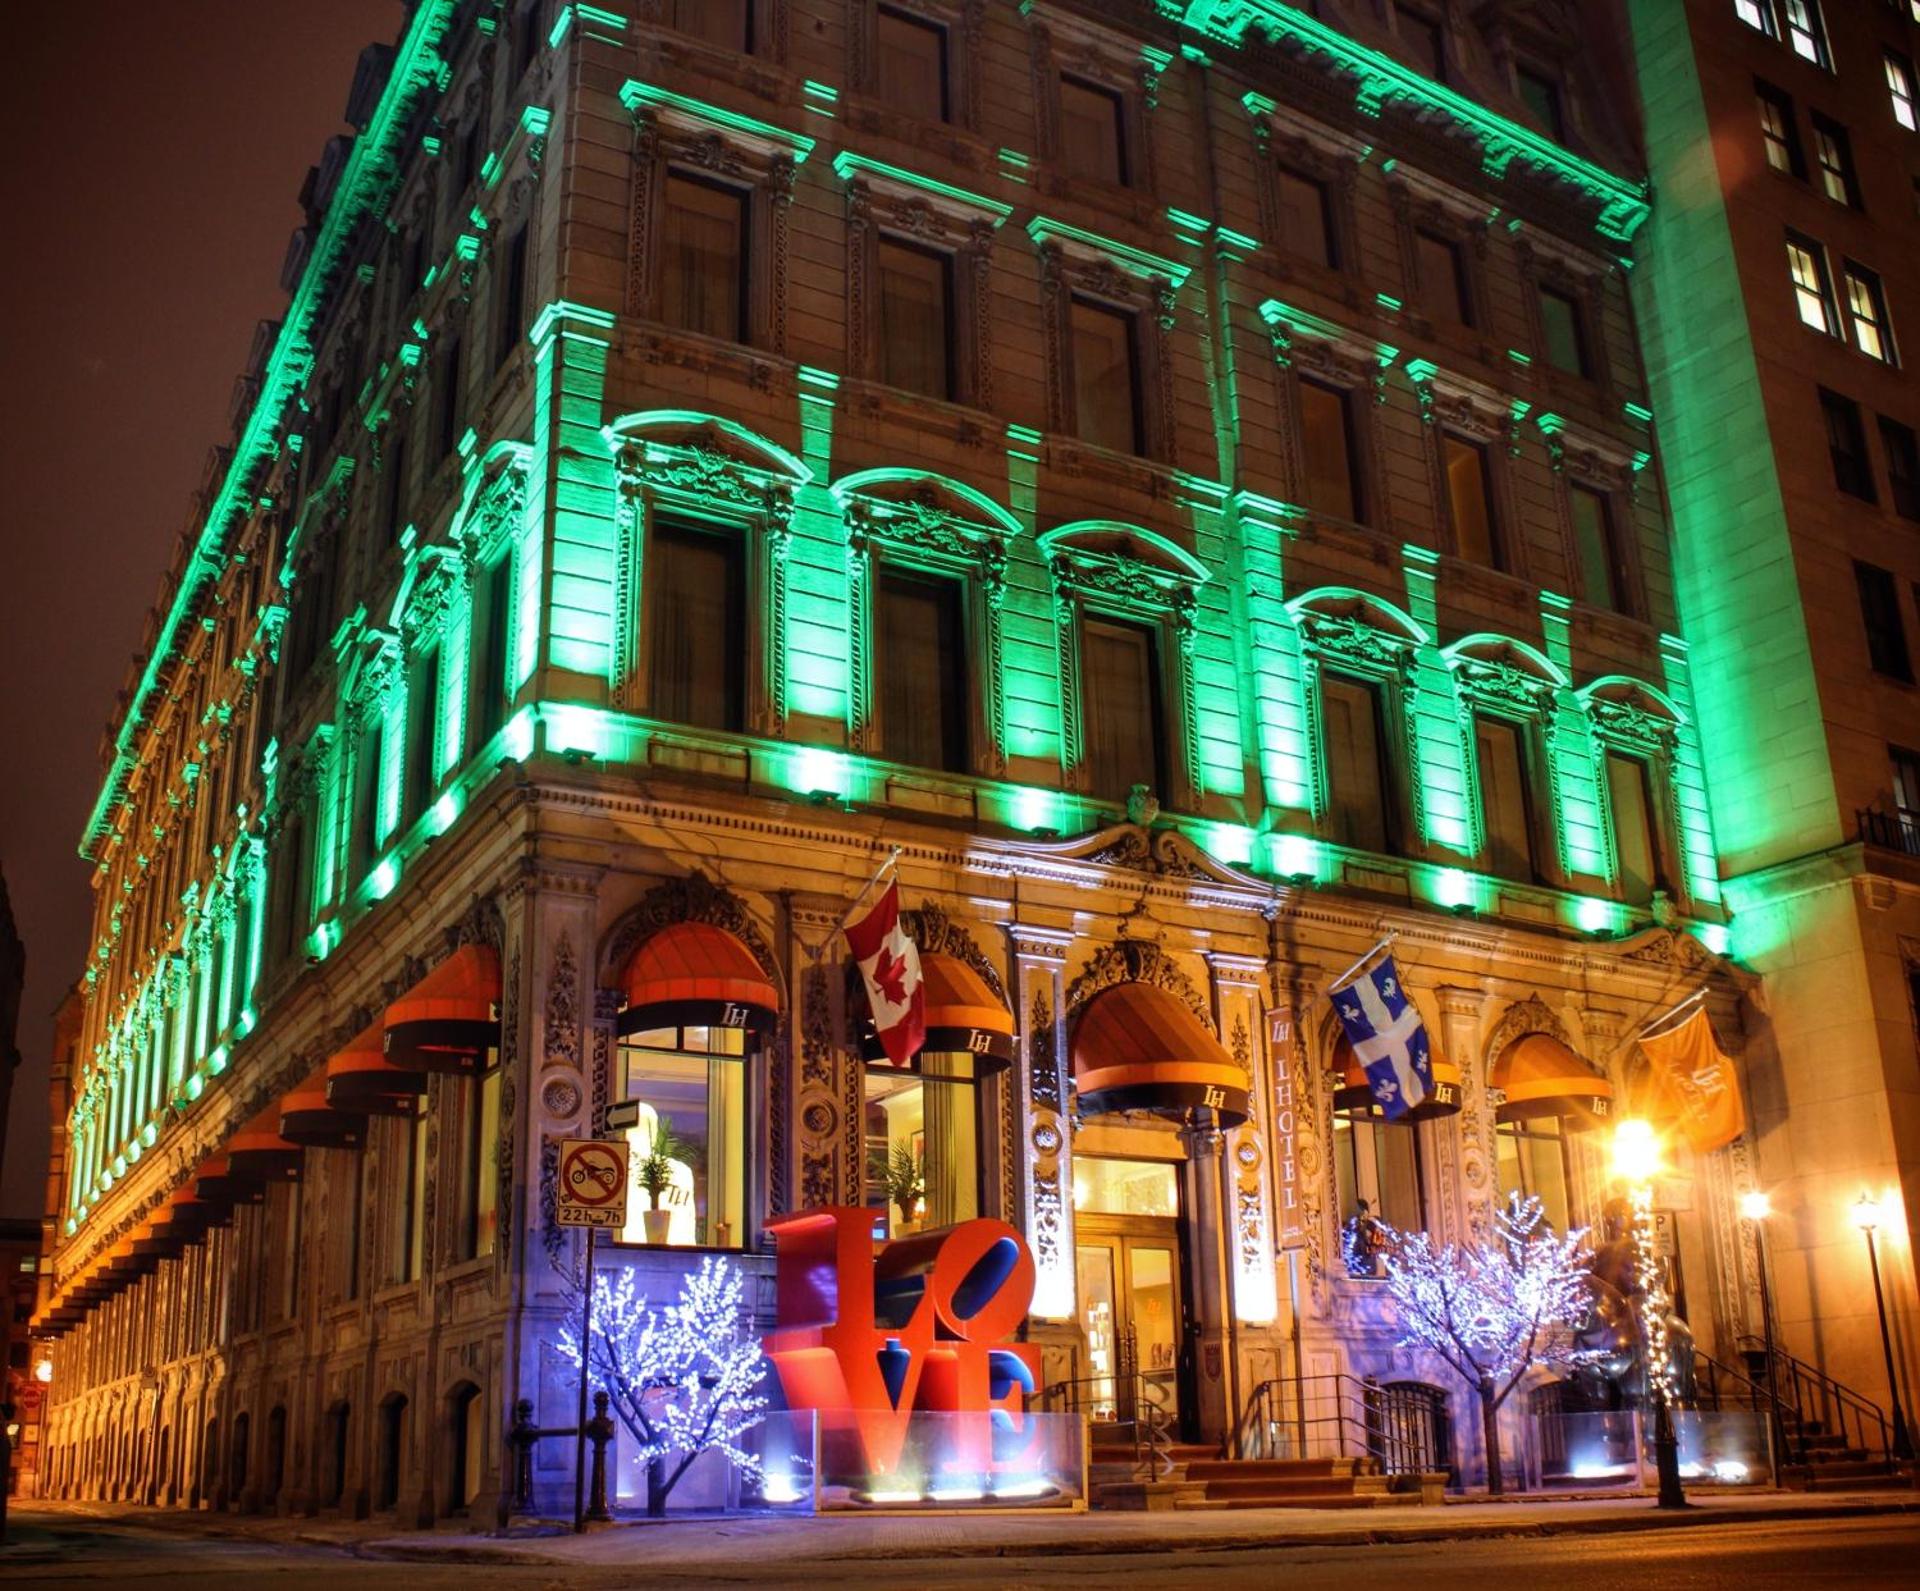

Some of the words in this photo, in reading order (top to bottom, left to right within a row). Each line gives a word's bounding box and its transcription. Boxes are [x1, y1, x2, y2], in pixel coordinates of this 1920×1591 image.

[721, 1003, 750, 1027] LH
[967, 1029, 992, 1053] LH
[1203, 1085, 1226, 1108] LH
